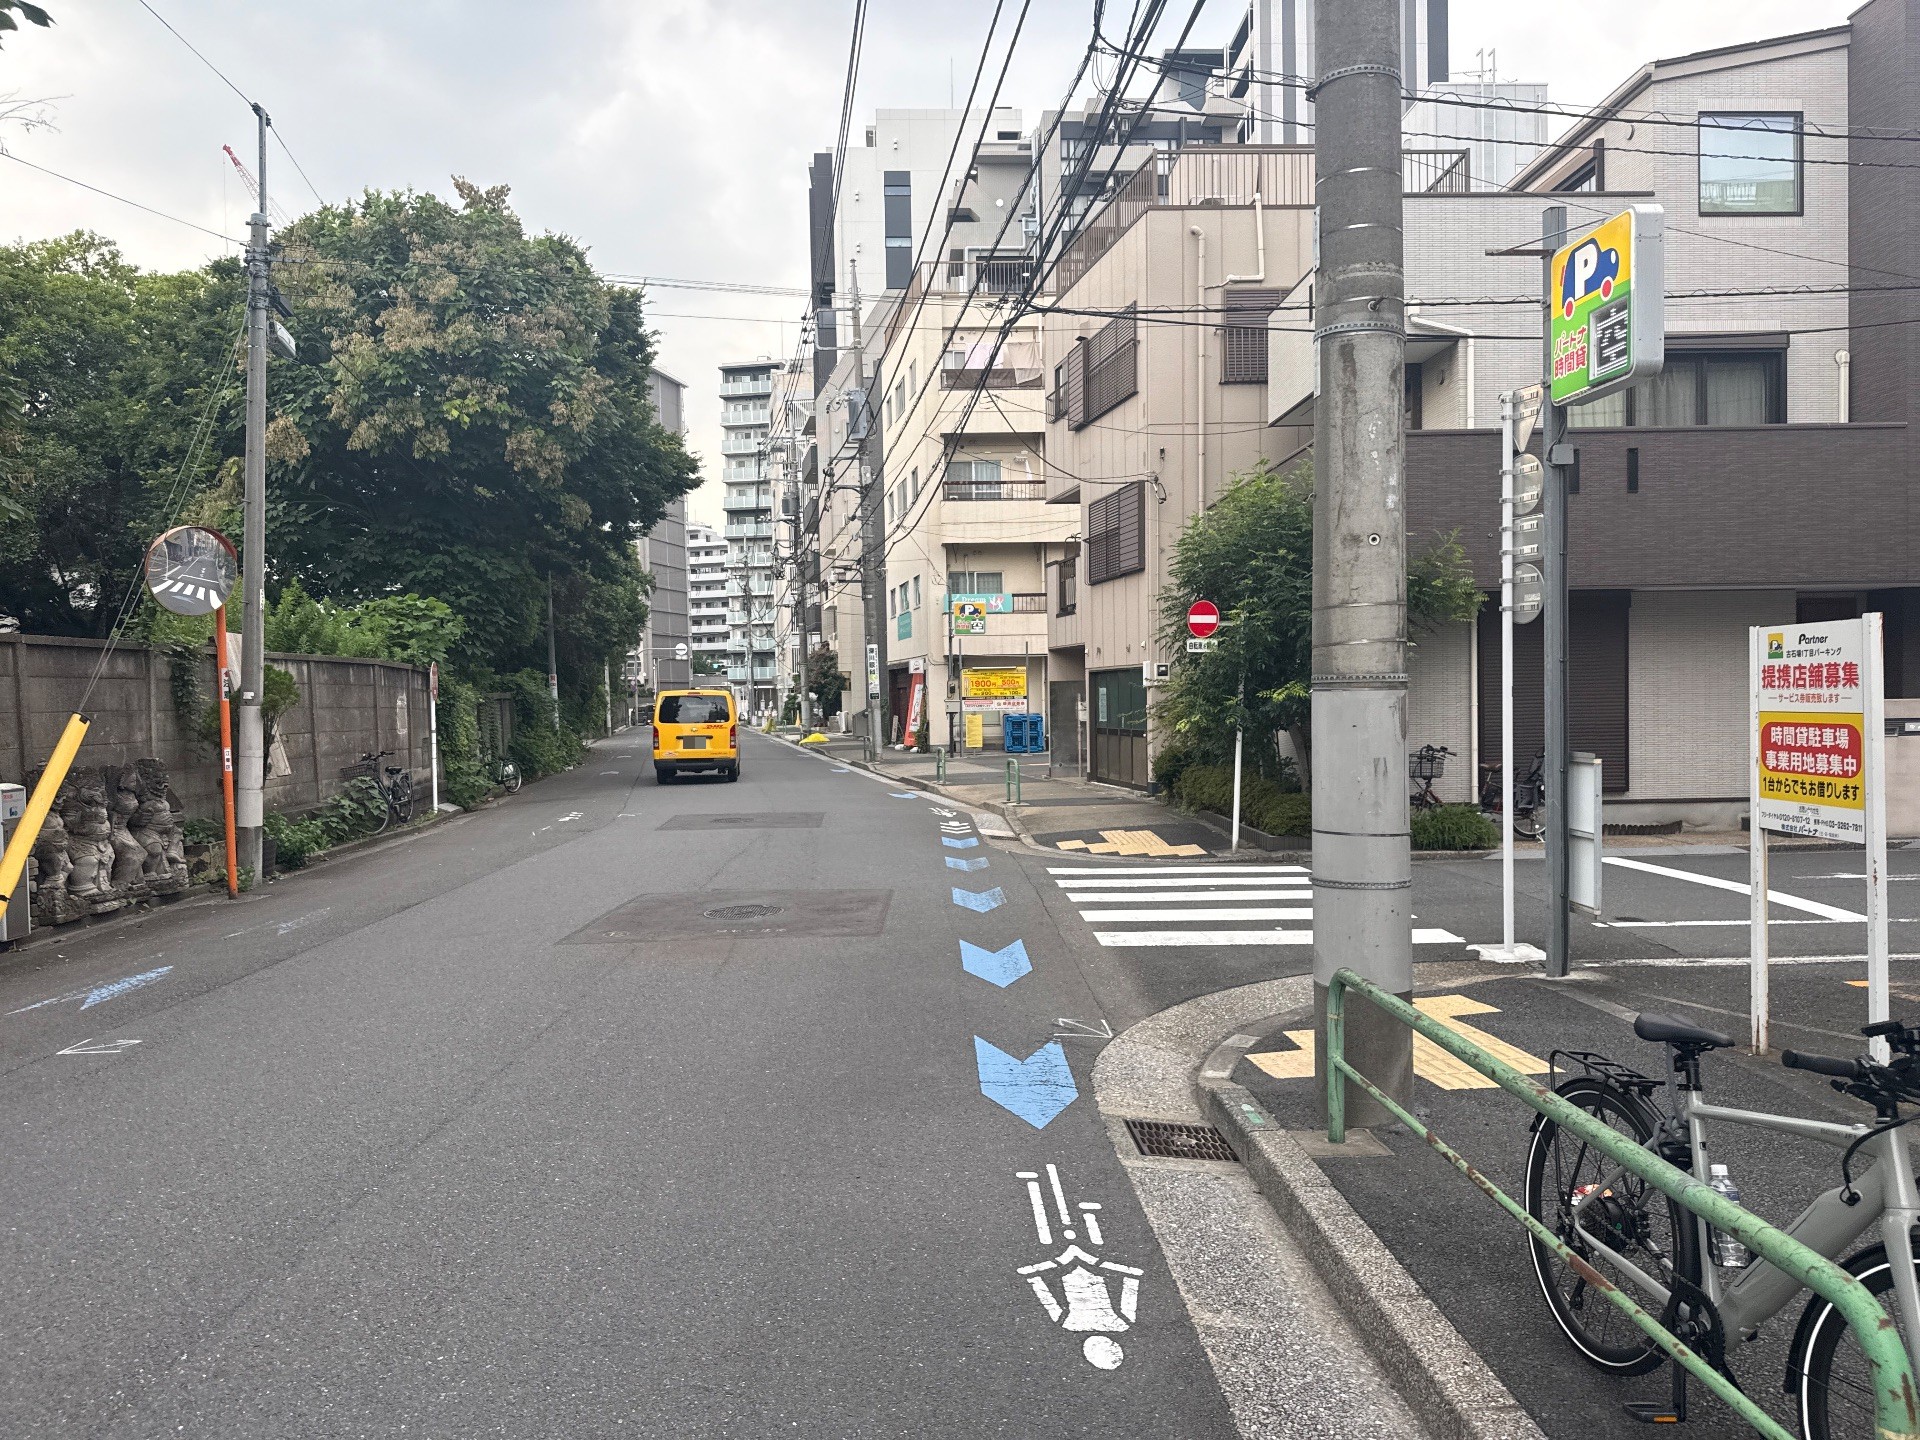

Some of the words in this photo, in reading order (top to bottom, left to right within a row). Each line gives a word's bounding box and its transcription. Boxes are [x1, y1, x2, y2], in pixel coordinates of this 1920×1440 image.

[1574, 243, 1598, 300] P
[1555, 326, 1587, 358] パートナ
[1554, 345, 1587, 378] 時間貸
[964, 604, 974, 615] P
[1798, 633, 1828, 645] Partner
[1762, 661, 1859, 689] 提携店舗募集
[1770, 726, 1849, 749] 時間貸駐車場
[1765, 750, 1857, 776] 事業用地募集中
[1763, 777, 1860, 801] 1台からでもお借りします
